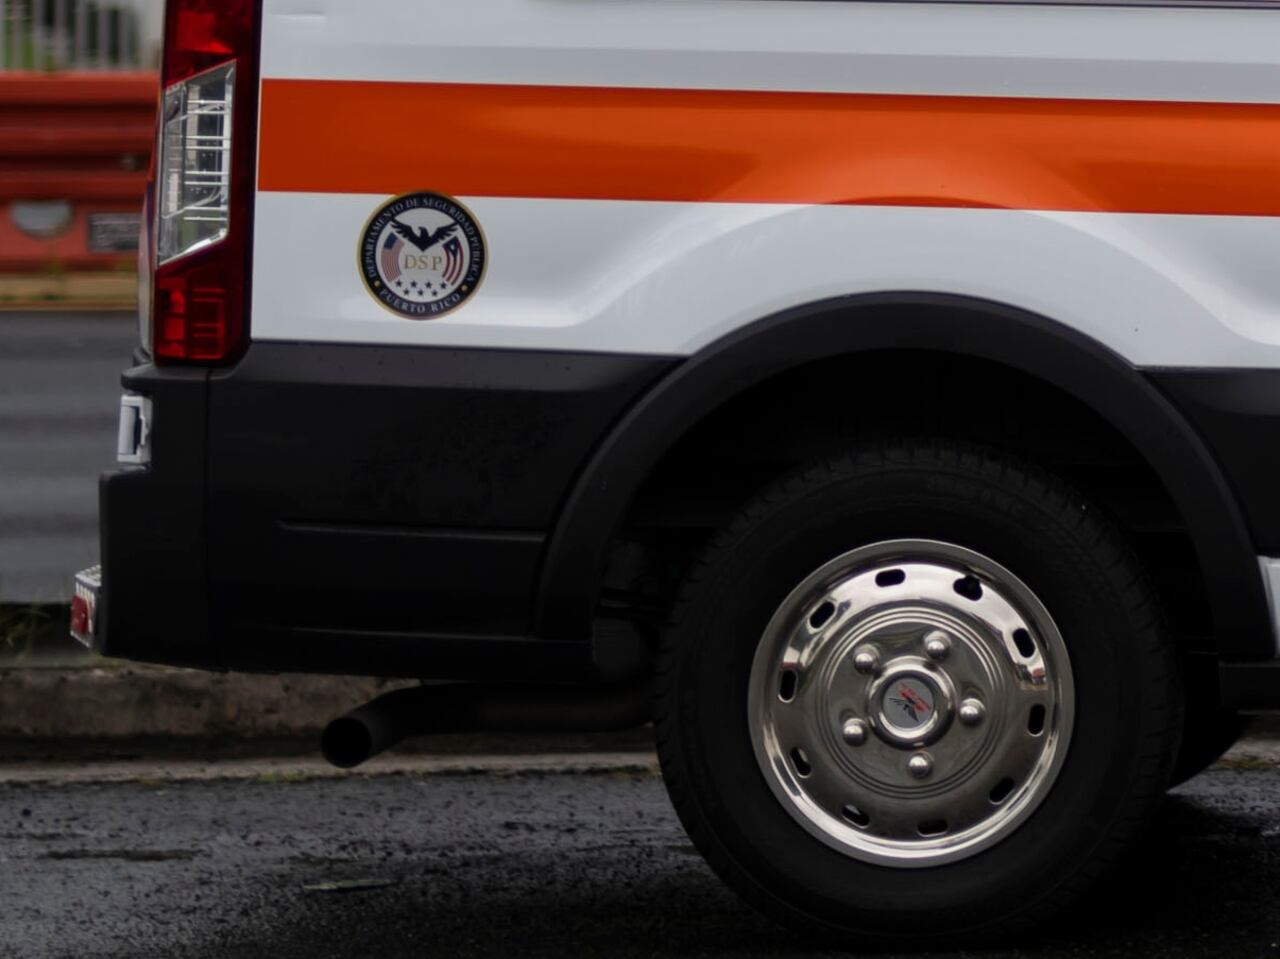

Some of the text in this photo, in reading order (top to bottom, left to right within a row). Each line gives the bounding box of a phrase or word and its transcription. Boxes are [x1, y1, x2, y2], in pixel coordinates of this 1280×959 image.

[364, 203, 404, 278] DEPARTAMENTO
[406, 198, 418, 209] DE
[422, 197, 475, 236] SEGURIDAD
[379, 289, 461, 313] PUERTO RICO
